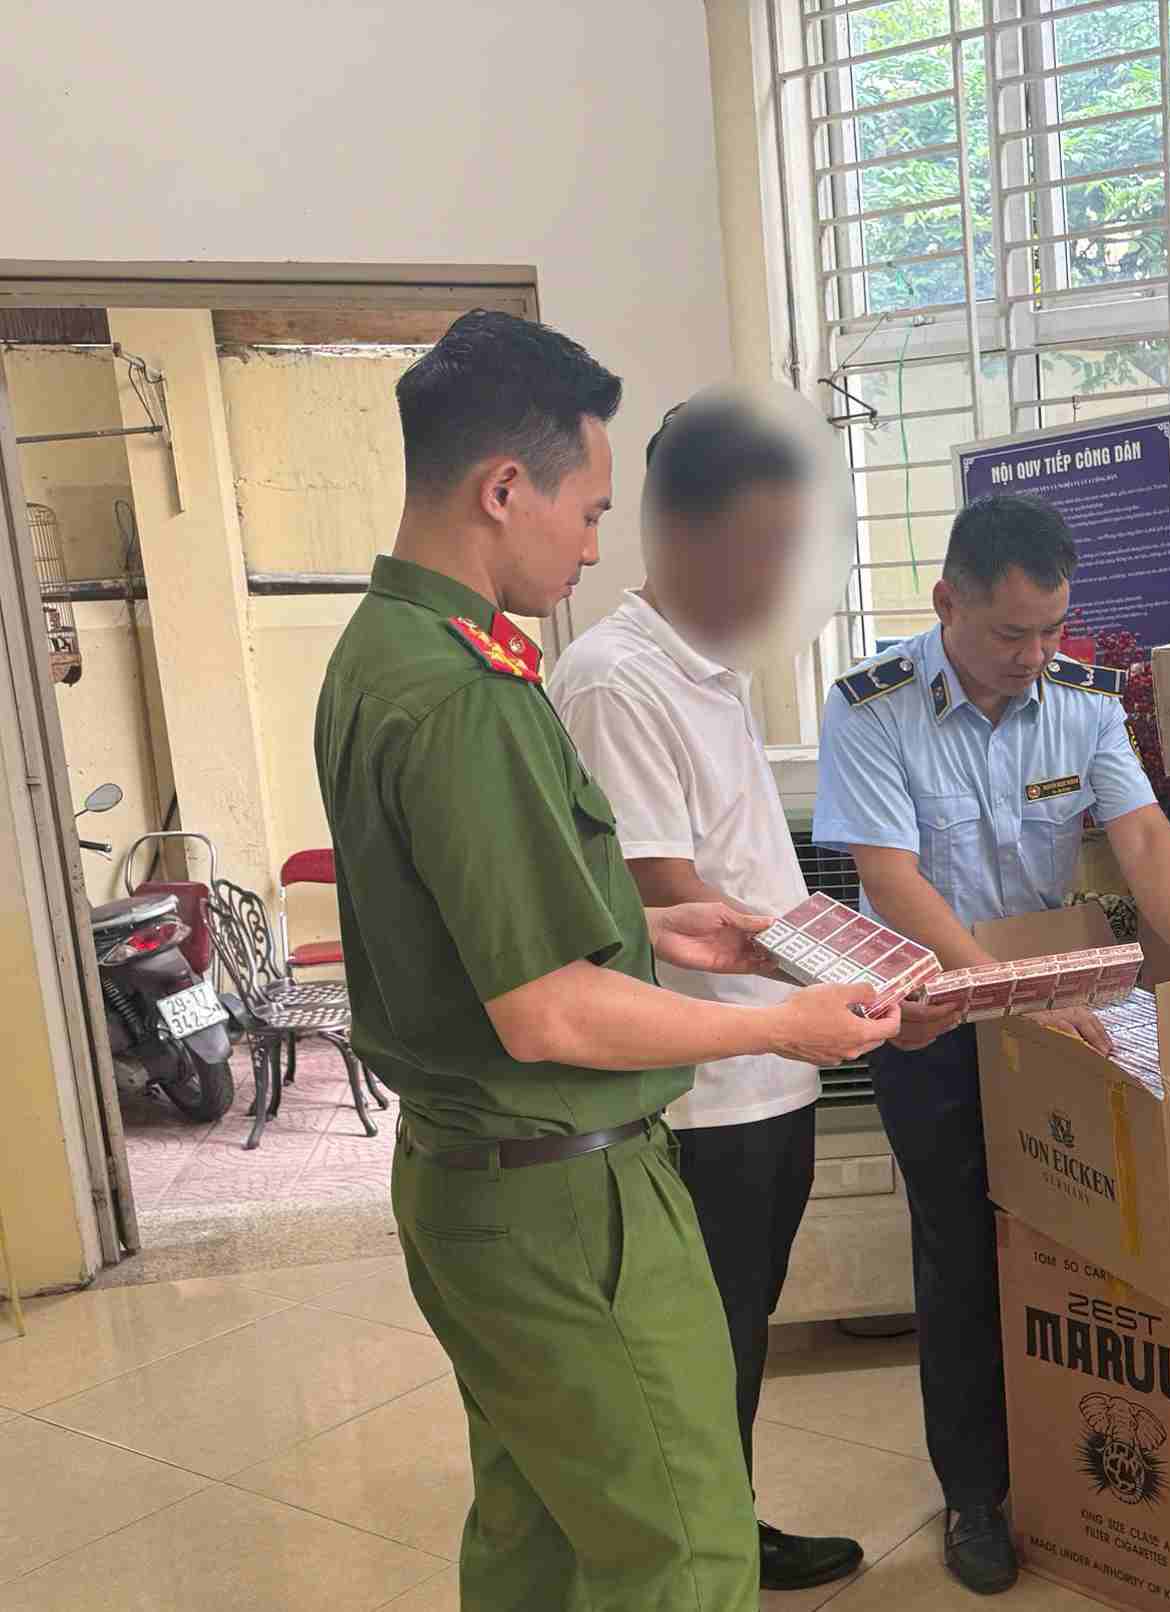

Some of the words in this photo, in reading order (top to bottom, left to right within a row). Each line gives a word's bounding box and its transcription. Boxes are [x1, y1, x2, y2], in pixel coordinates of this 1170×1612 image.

[991, 464, 1013, 486] NỘI
[1016, 459, 1041, 480] QUY
[1045, 449, 1072, 475] TIẾP
[1075, 447, 1111, 470] CÔNG
[1114, 440, 1141, 463] DÂN
[1018, 1129, 1049, 1166] VON
[1053, 1148, 1115, 1202] EICKEN
[1067, 1291, 1163, 1335] ZEST
[1080, 1508, 1104, 1526] KING
[1108, 1518, 1126, 1534] SIZE
[1130, 1527, 1161, 1547] CLASS
[1163, 1541, 1170, 1552] A
[1085, 1525, 1111, 1544] FILTER
[1114, 1538, 1169, 1567] CIGARETTES
[1029, 1536, 1057, 1553] MADE
[1059, 1549, 1092, 1569] UNDER
[1093, 1559, 1145, 1589] AUTHORITY
[1147, 1582, 1162, 1595] OF
